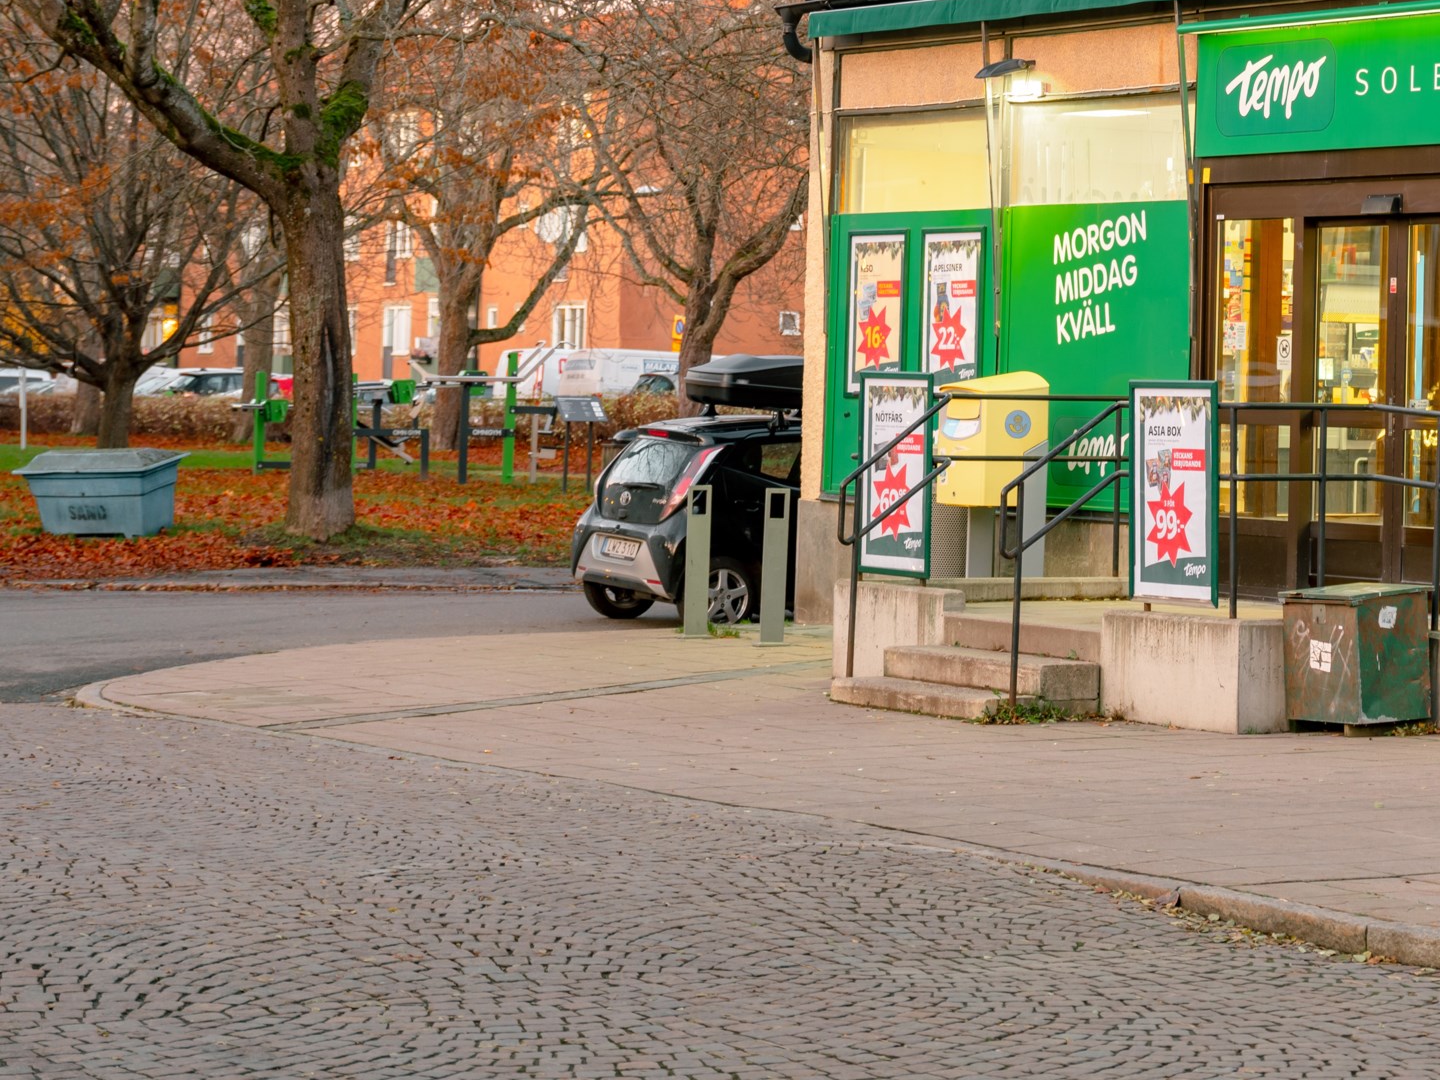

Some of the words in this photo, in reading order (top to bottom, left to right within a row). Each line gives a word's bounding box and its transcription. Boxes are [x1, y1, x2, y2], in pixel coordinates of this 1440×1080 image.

[1053, 209, 1147, 265] MORGON
[933, 263, 963, 273] APELSINER
[1055, 254, 1138, 305] MIDDAG
[1056, 299, 1116, 345] KVÄLL
[875, 410, 903, 423] NÖTFÄRS
[1148, 425, 1166, 436] ASIA
[1167, 425, 1181, 437] BOX
